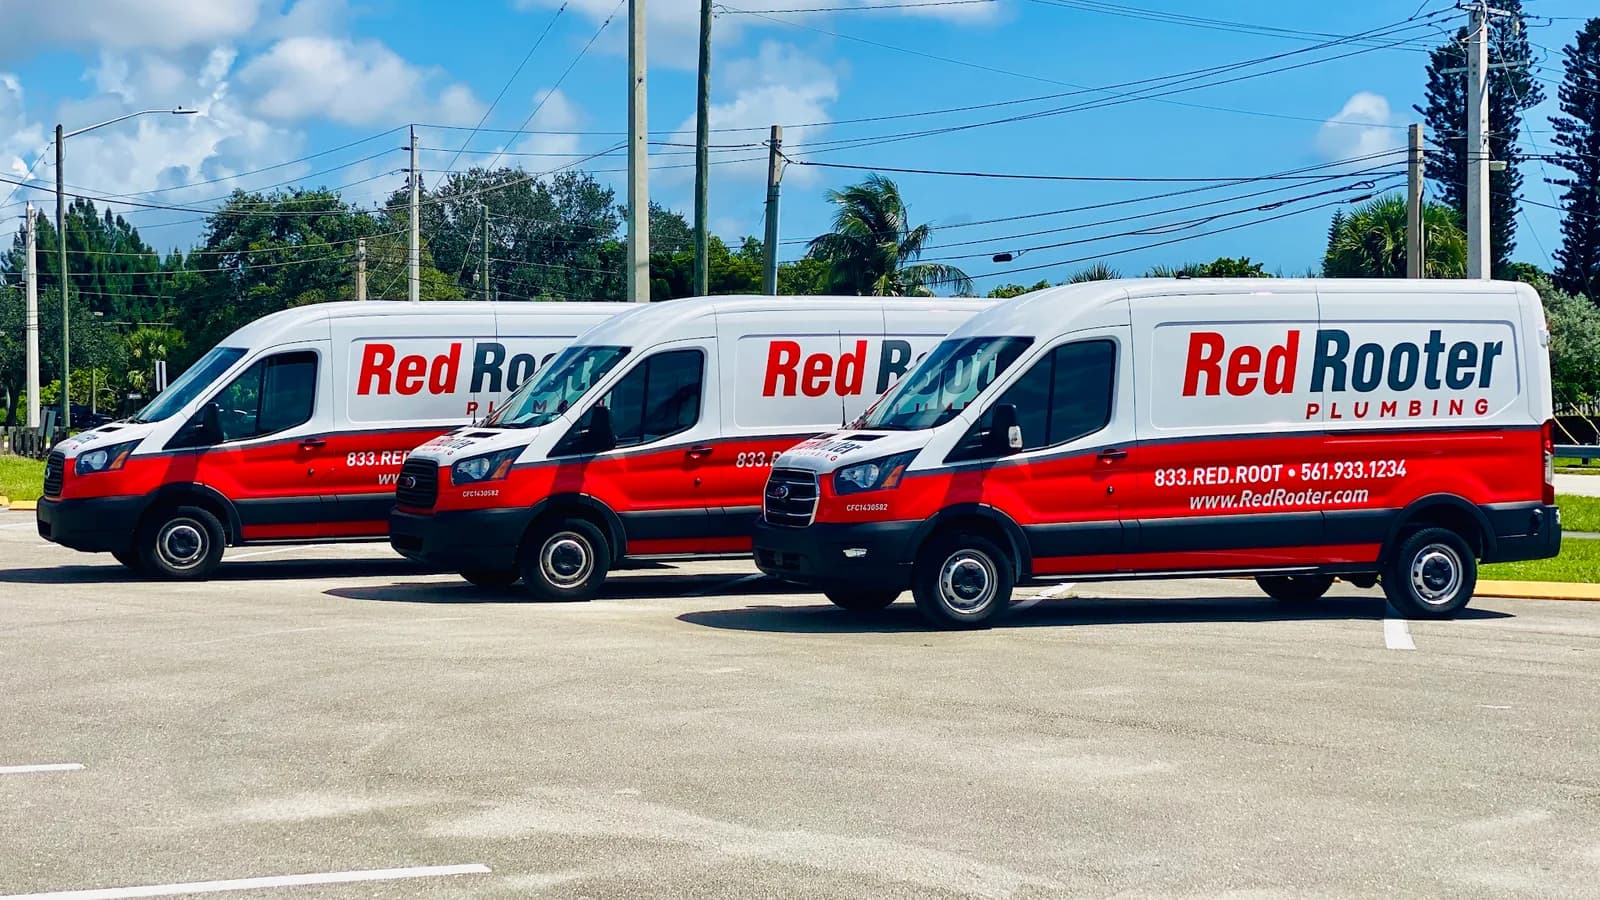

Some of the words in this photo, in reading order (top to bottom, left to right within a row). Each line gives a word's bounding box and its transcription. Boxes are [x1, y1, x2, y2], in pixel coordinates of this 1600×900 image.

[357, 342, 462, 396] Red
[763, 340, 868, 397] Red
[1182, 330, 1300, 397] Red
[1309, 329, 1503, 393] Rooter
[1305, 398, 1490, 420] PLUMBING
[1154, 464, 1284, 487] 833.RED.ROOT
[1300, 459, 1407, 481] 561.933.1234
[1189, 488, 1369, 510] www.RedRooter.com
